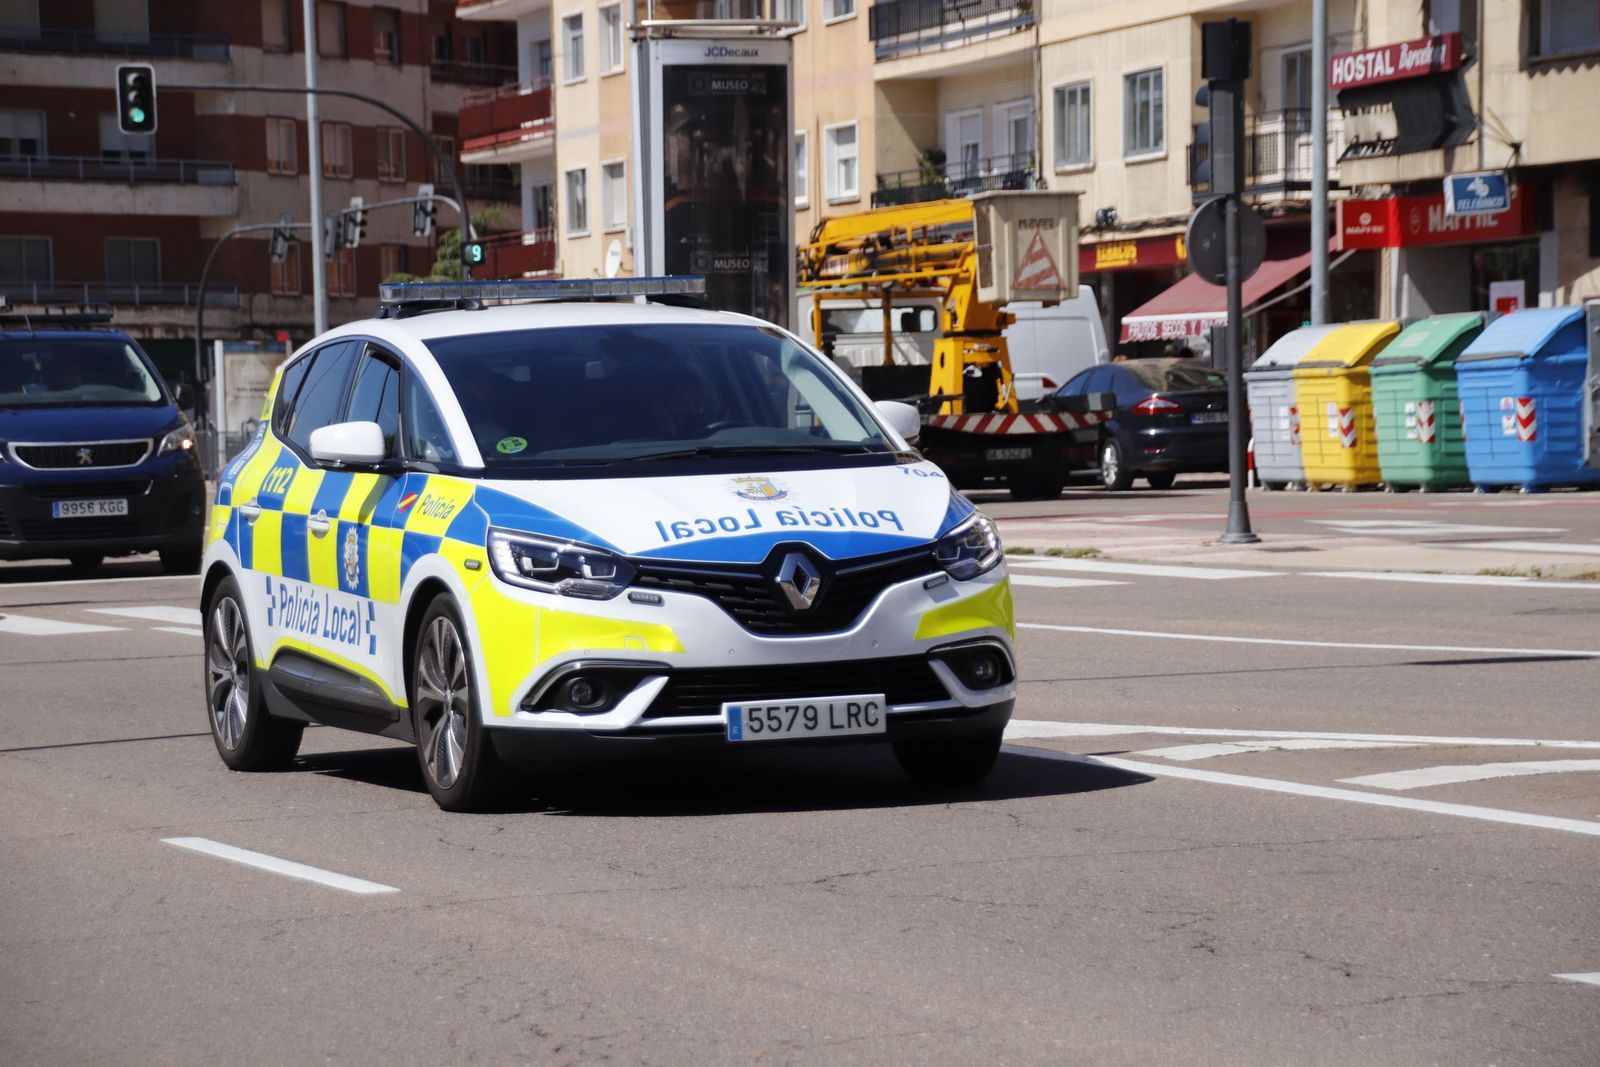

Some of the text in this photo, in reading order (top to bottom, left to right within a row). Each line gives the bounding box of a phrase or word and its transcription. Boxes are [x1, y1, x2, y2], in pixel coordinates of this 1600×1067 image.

[704, 46, 759, 57] JCDecaux
[1332, 48, 1395, 85] HOSTAL
[711, 80, 748, 90] MUSEO
[1346, 225, 1385, 235] MAPFRE
[713, 259, 750, 269] MUSEO
[1162, 320, 1187, 337] SECOS
[896, 465, 944, 477] 704
[267, 467, 293, 494] 112
[62, 501, 124, 514] 9956 KGG
[417, 493, 455, 520] Policía
[279, 583, 361, 646] Policía Local
[747, 701, 879, 733] 5579 LRC
